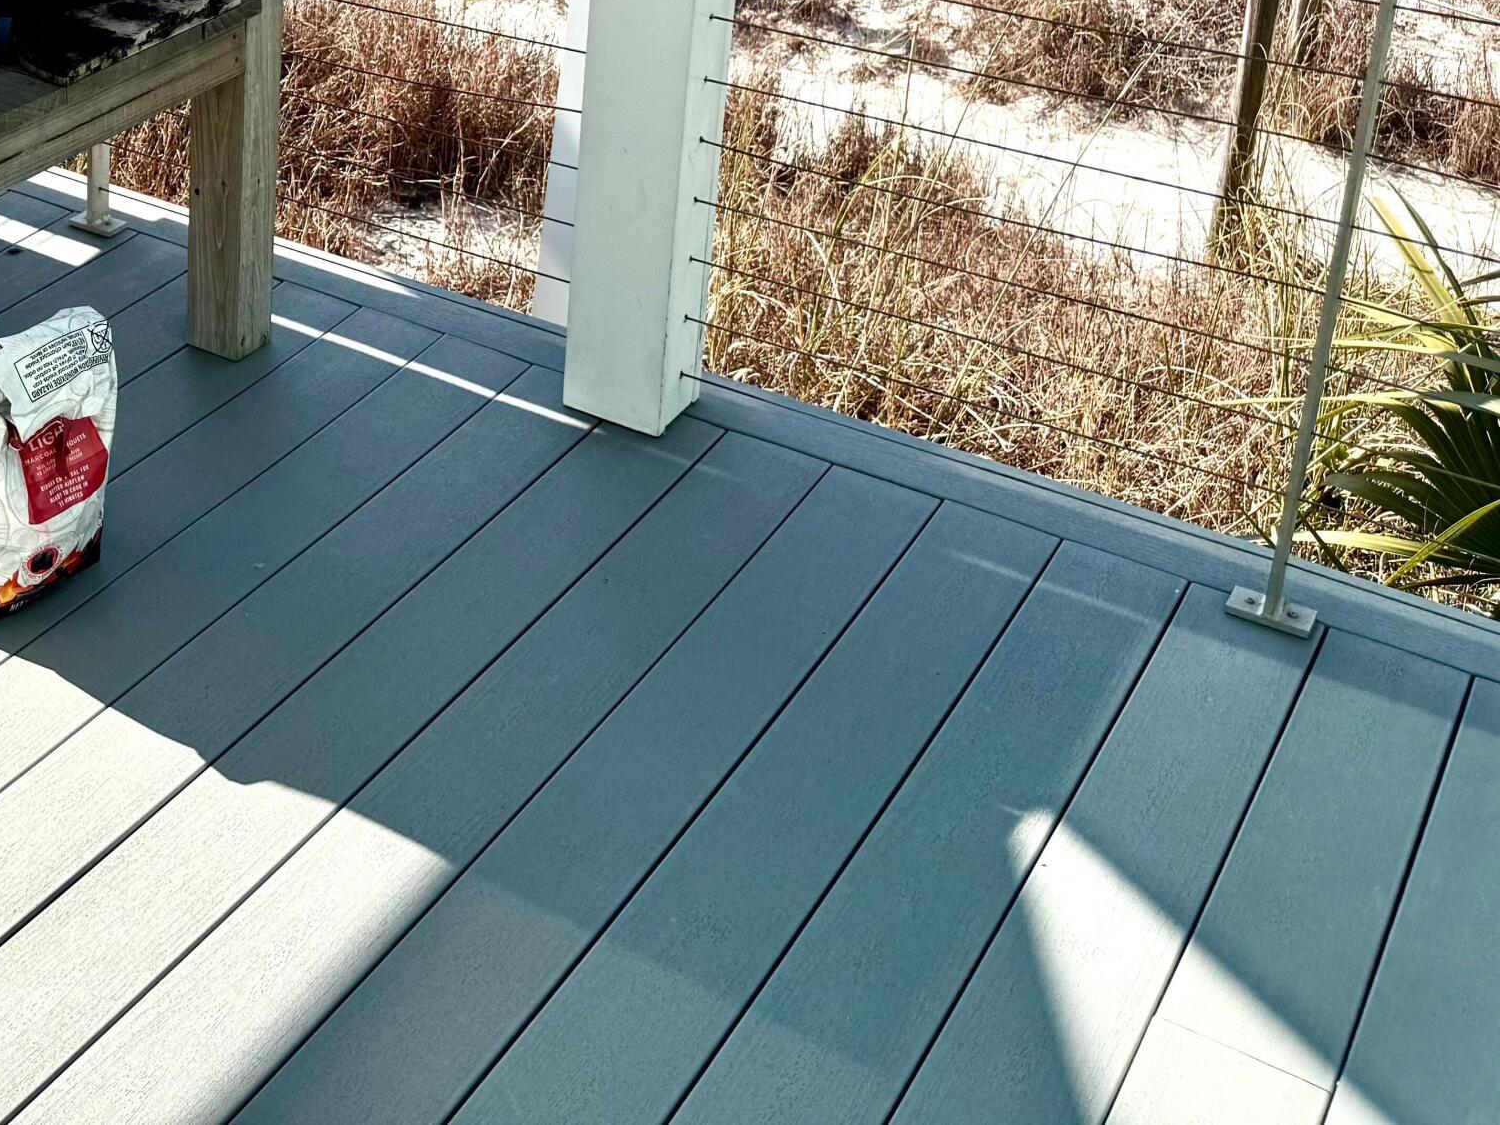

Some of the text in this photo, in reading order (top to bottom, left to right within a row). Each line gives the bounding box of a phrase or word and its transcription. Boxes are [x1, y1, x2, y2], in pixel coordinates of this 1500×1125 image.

[40, 346, 62, 361] charcoal
[25, 359, 40, 369] inside
[54, 368, 78, 388] MONOXIDE
[32, 382, 54, 398] HAZARD
[64, 475, 85, 488] AIRFLOW
